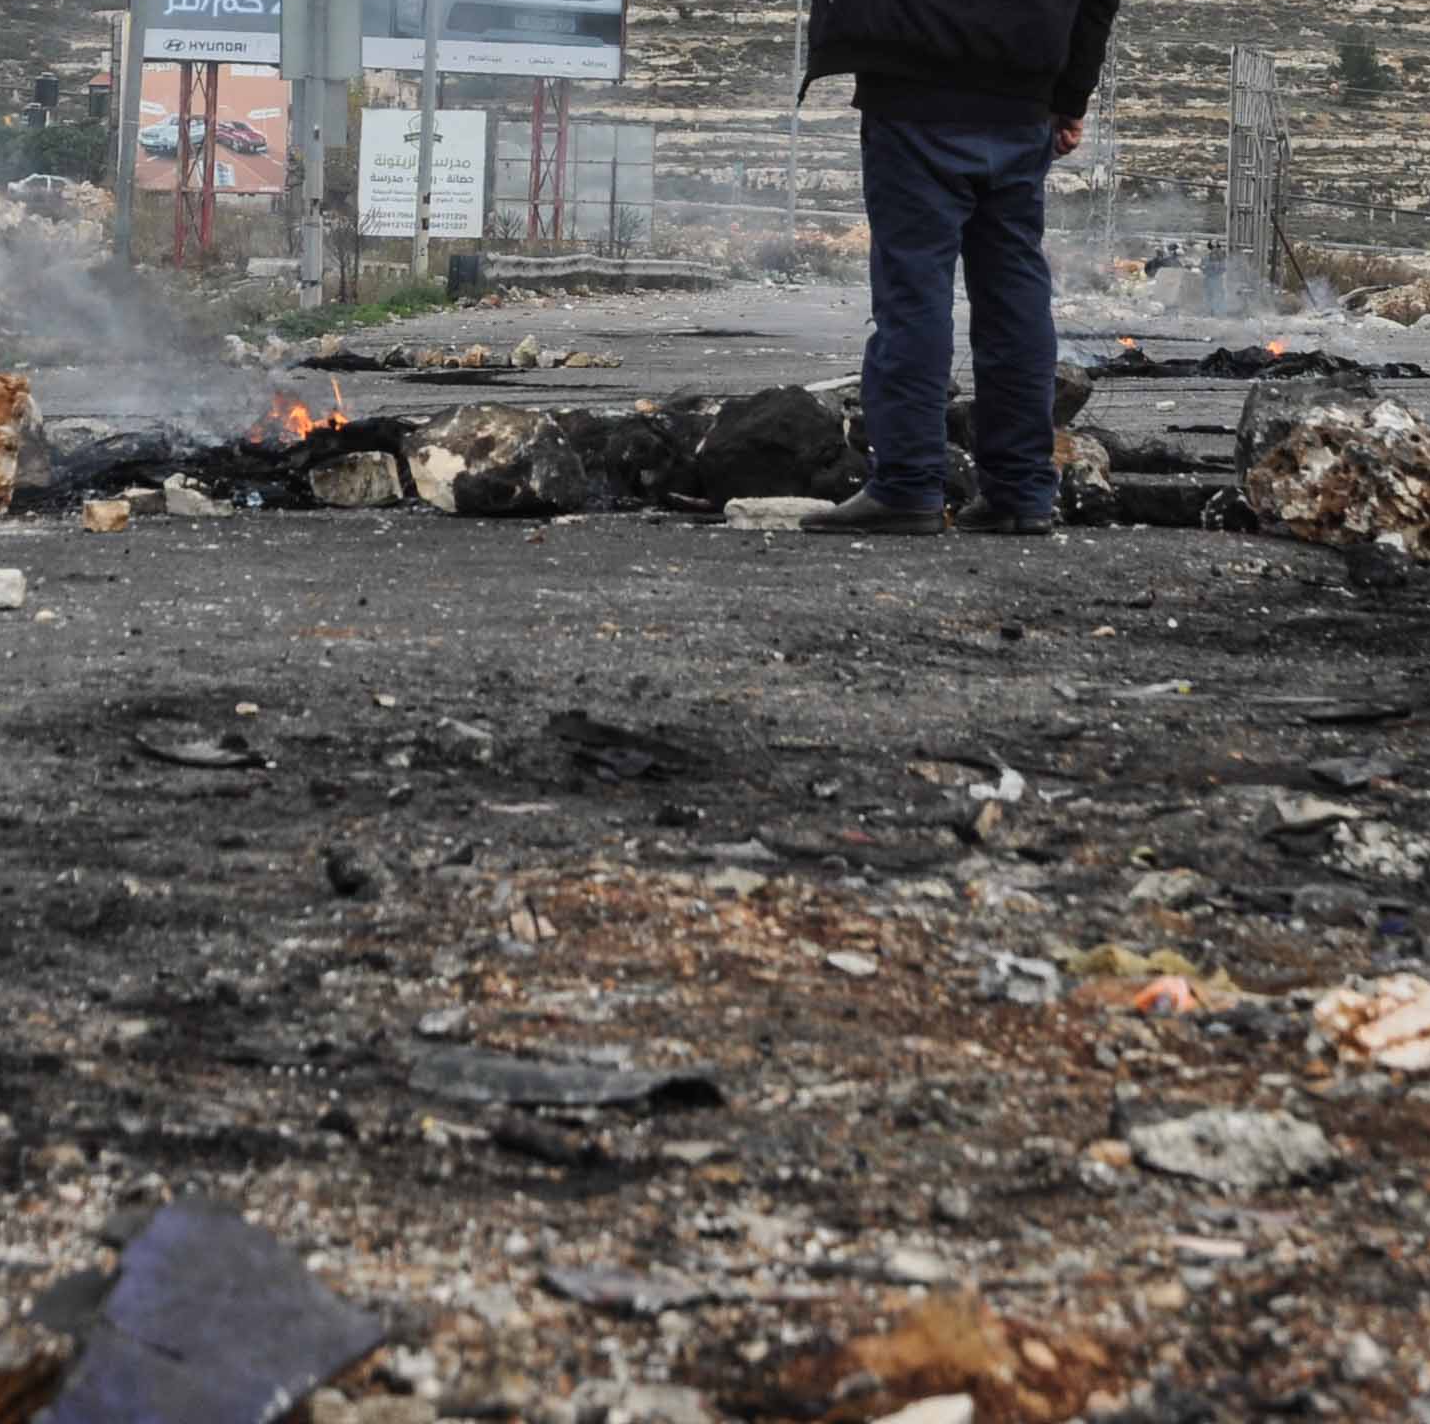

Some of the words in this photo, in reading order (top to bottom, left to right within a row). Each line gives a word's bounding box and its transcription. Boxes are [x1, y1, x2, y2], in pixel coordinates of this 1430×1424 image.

[189, 40, 247, 53] HYUNDAI
[374, 152, 417, 170] لزيتونة
[432, 157, 471, 170] مدرس
